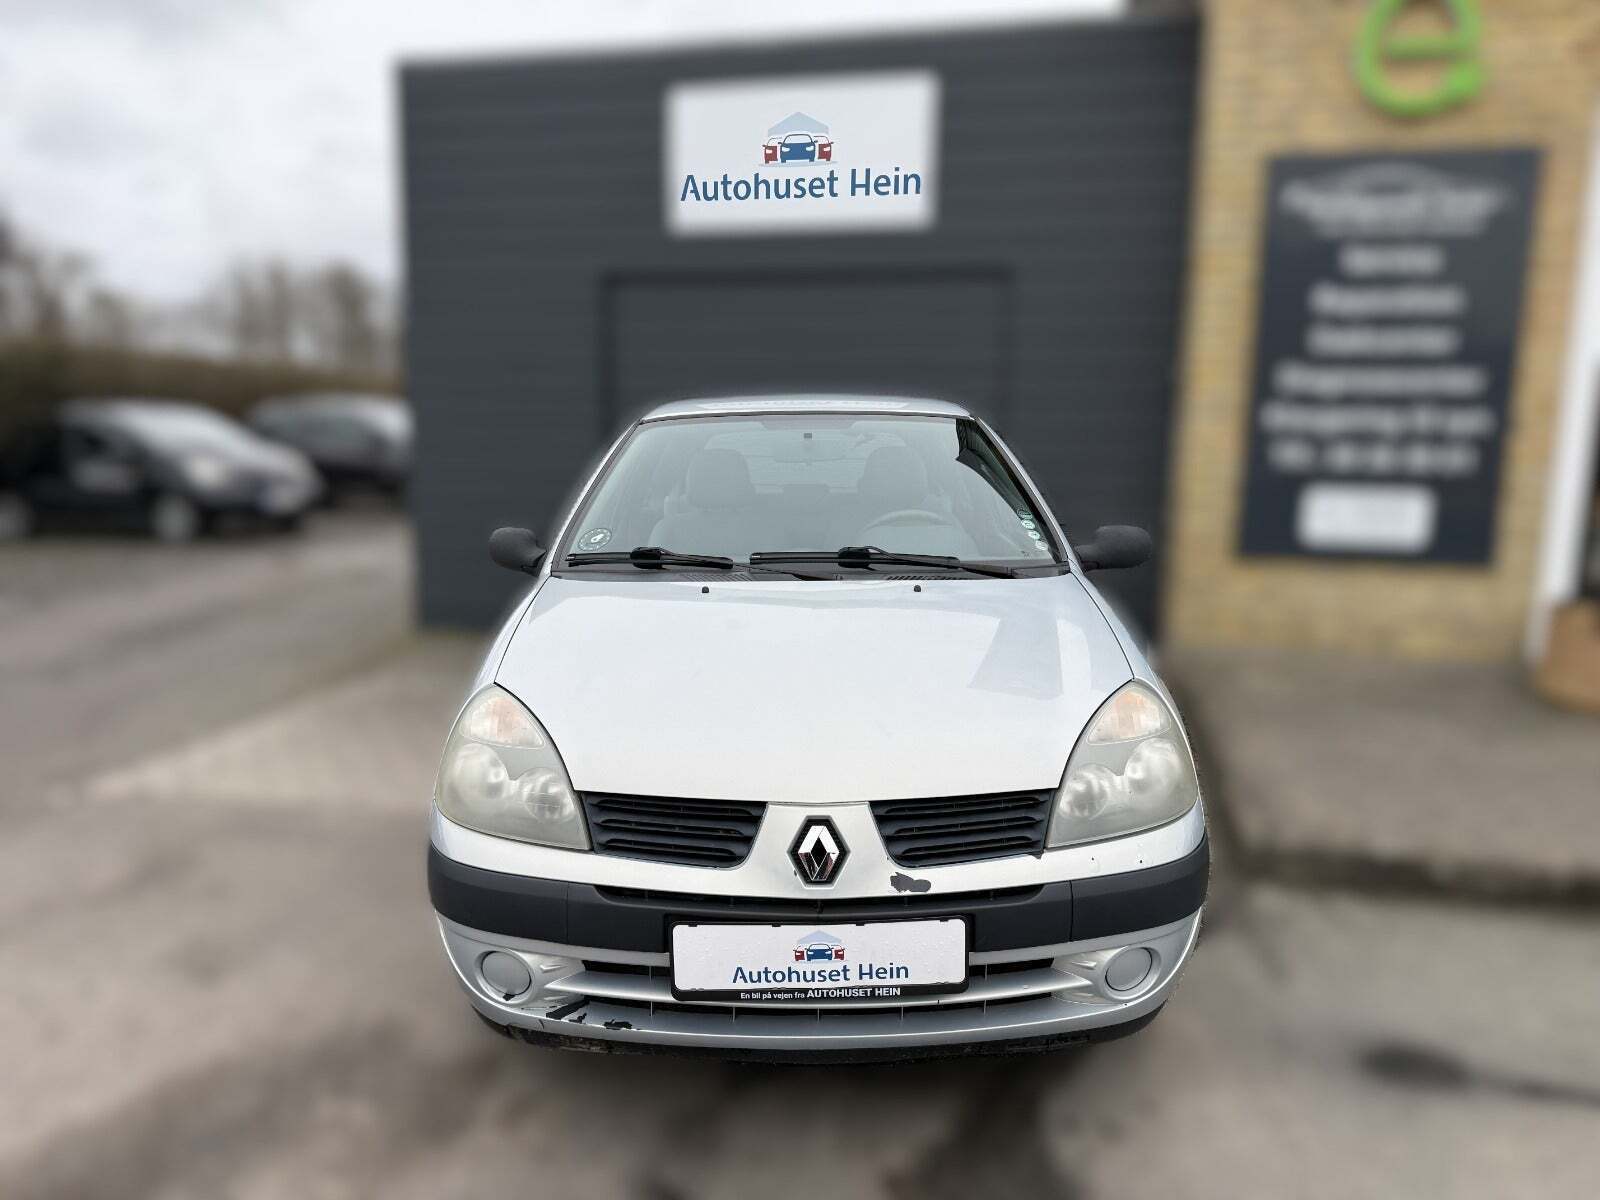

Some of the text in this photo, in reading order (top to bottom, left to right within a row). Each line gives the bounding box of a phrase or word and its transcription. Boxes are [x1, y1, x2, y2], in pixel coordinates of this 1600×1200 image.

[680, 166, 921, 202] Autohuset Hein
[732, 962, 909, 984] Autohuset Hein
[762, 991, 772, 1000] på
[773, 991, 793, 1000] vejen
[794, 991, 805, 999] fra
[806, 987, 873, 998] AUTOHUSET
[874, 987, 901, 997] HEIN
